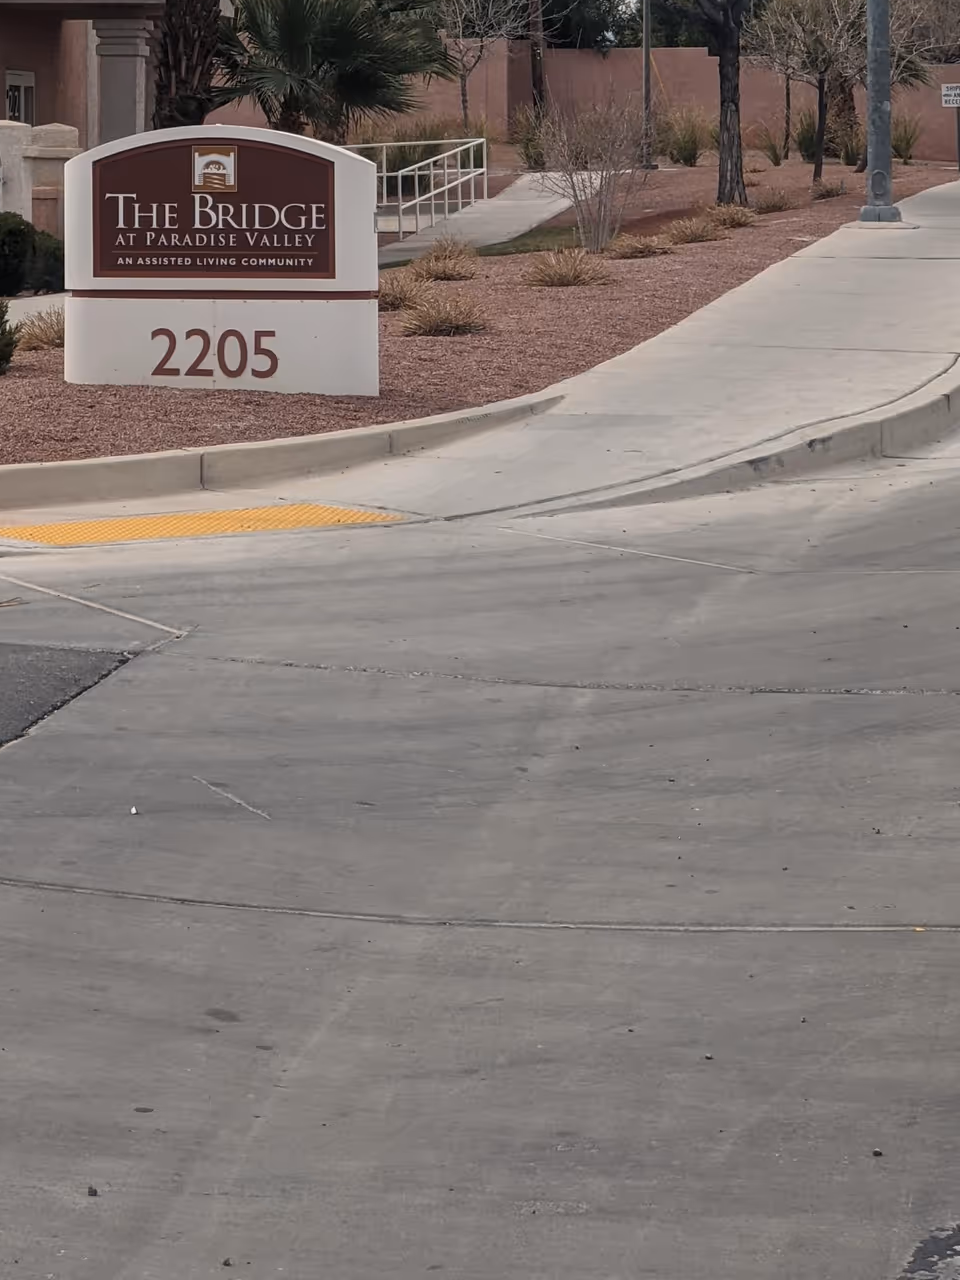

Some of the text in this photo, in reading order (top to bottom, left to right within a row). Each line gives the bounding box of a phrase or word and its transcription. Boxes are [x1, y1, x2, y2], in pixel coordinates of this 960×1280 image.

[105, 193, 326, 230] THE BRIDGE
[115, 232, 316, 247] AT PARADISE VALLEY
[117, 257, 314, 266] AN ASSISTED LIVING COMMUNITY
[150, 327, 279, 379] 2205
